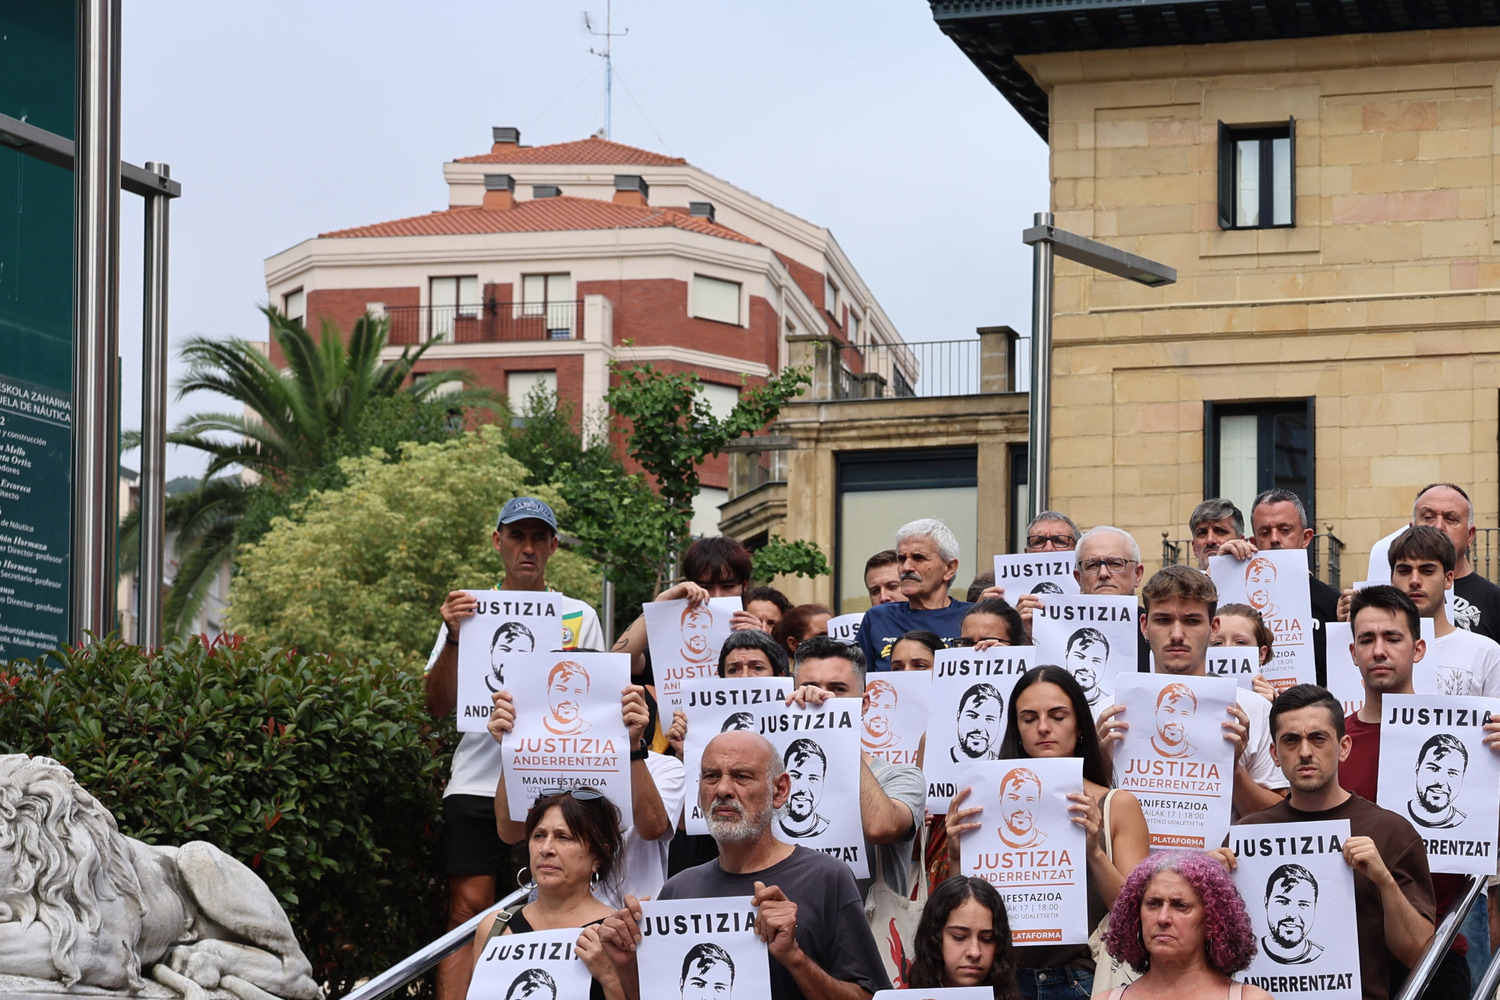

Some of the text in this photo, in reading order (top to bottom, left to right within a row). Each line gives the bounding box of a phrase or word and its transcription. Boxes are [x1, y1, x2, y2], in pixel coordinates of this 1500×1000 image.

[20, 401, 32, 413] DE
[31, 391, 71, 411] ZAHARRA
[1002, 562, 1070, 578] JUSTIZI
[470, 602, 556, 617] USTIZIA
[664, 664, 718, 681] JUSTIZ
[938, 658, 1028, 677] JUSTIZIA
[1209, 659, 1253, 675] IZIA
[689, 688, 786, 707] JUSTIZIA
[760, 711, 852, 735] JUSTIZIA
[514, 738, 616, 754] JUSTIZIA
[513, 756, 618, 767] ANDERRENTZAT
[1125, 758, 1220, 780] JUSTIZIA
[522, 776, 607, 787] MANIFESTAZIOA
[1122, 777, 1222, 792] ANDERRENTZAT
[1138, 799, 1208, 812] ANIFESTAZIOA
[1184, 811, 1205, 820] 18:00
[1152, 836, 1204, 846] PLATAFORMA
[1233, 834, 1342, 858] JUSTIZIA
[1423, 839, 1491, 857] RRENTZAT
[973, 850, 1072, 870] JUSTIZIA
[1038, 903, 1059, 911] 18:00
[644, 913, 756, 937] JUSTIZIA
[1011, 931, 1061, 941] LATAFORMA
[486, 942, 580, 962] JUSTIZI
[1243, 973, 1353, 994] ANDERRENTZAT
